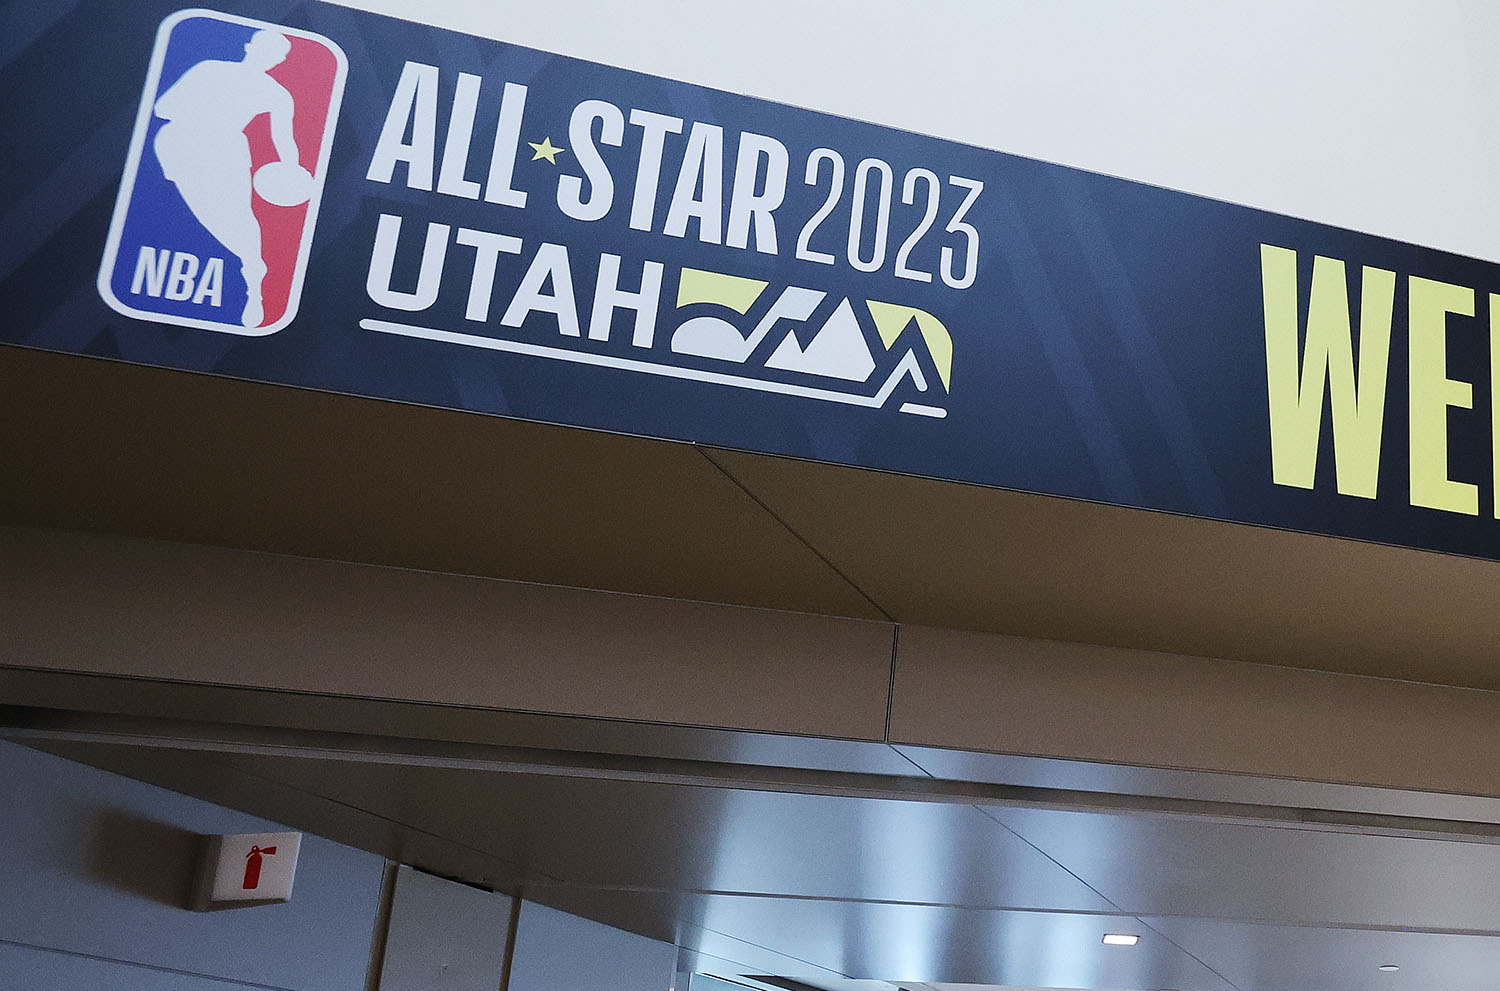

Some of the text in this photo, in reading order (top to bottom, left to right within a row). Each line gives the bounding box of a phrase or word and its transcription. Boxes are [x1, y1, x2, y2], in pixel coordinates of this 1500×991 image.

[131, 246, 224, 307] NBA
[365, 213, 667, 350] UTAH
[795, 148, 985, 289] 2023
